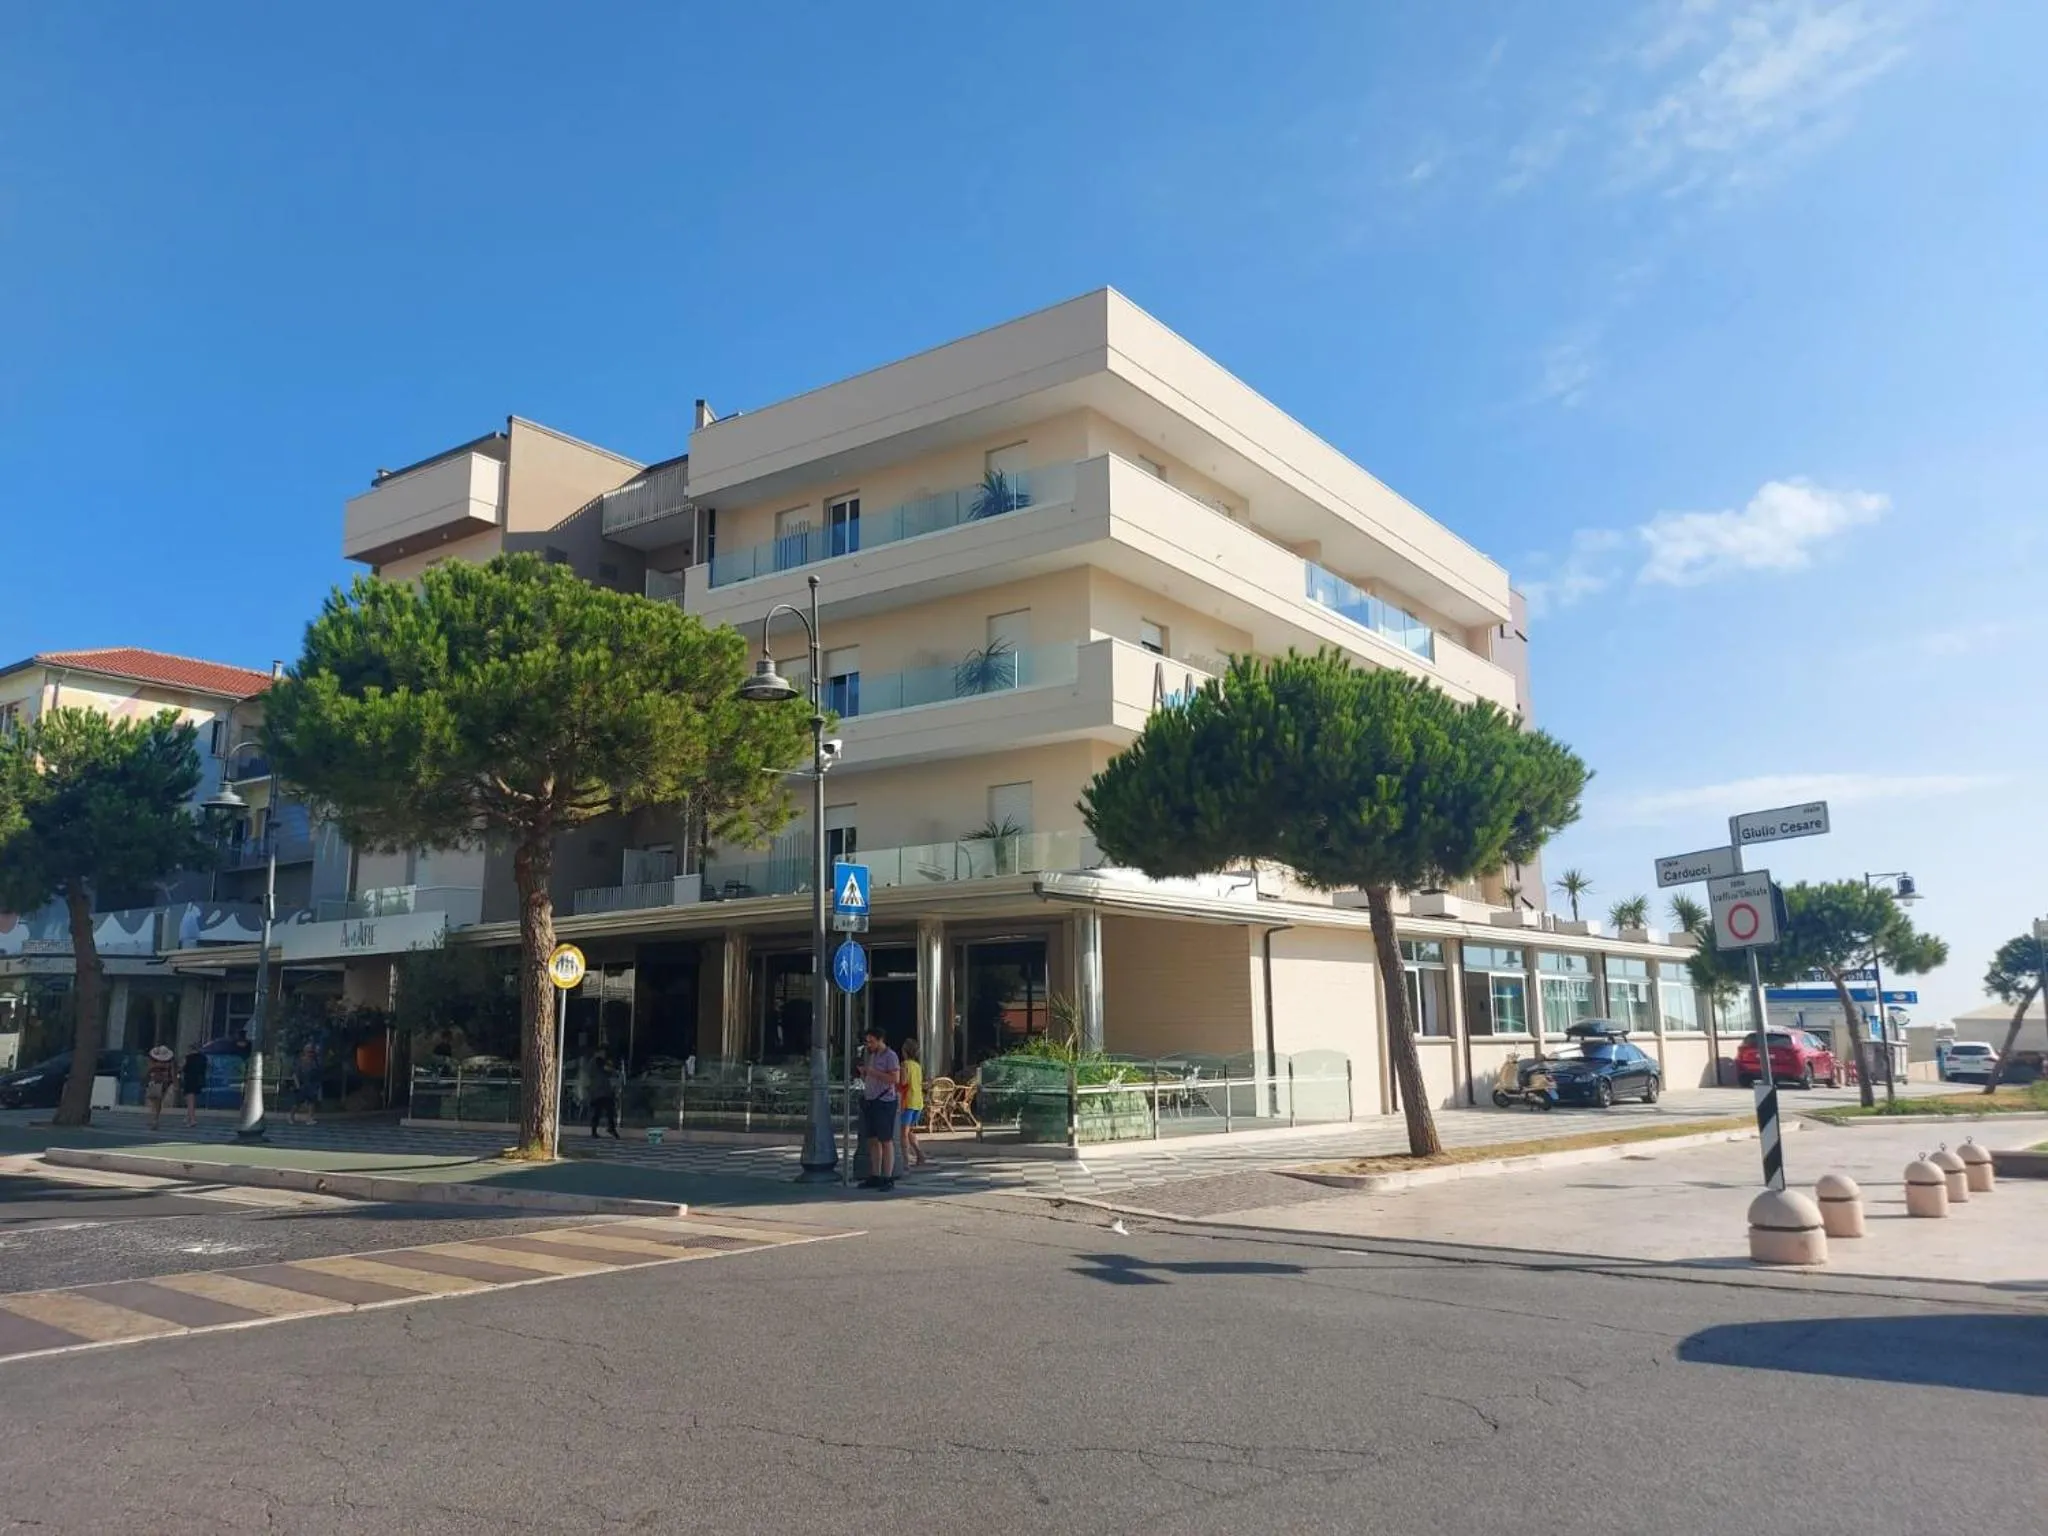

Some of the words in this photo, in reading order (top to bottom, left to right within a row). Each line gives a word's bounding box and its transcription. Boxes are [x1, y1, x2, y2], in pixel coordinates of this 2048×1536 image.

[1742, 826, 1776, 840] Giulio
[1780, 818, 1823, 834] Cesare
[1664, 864, 1712, 882] Carducci
